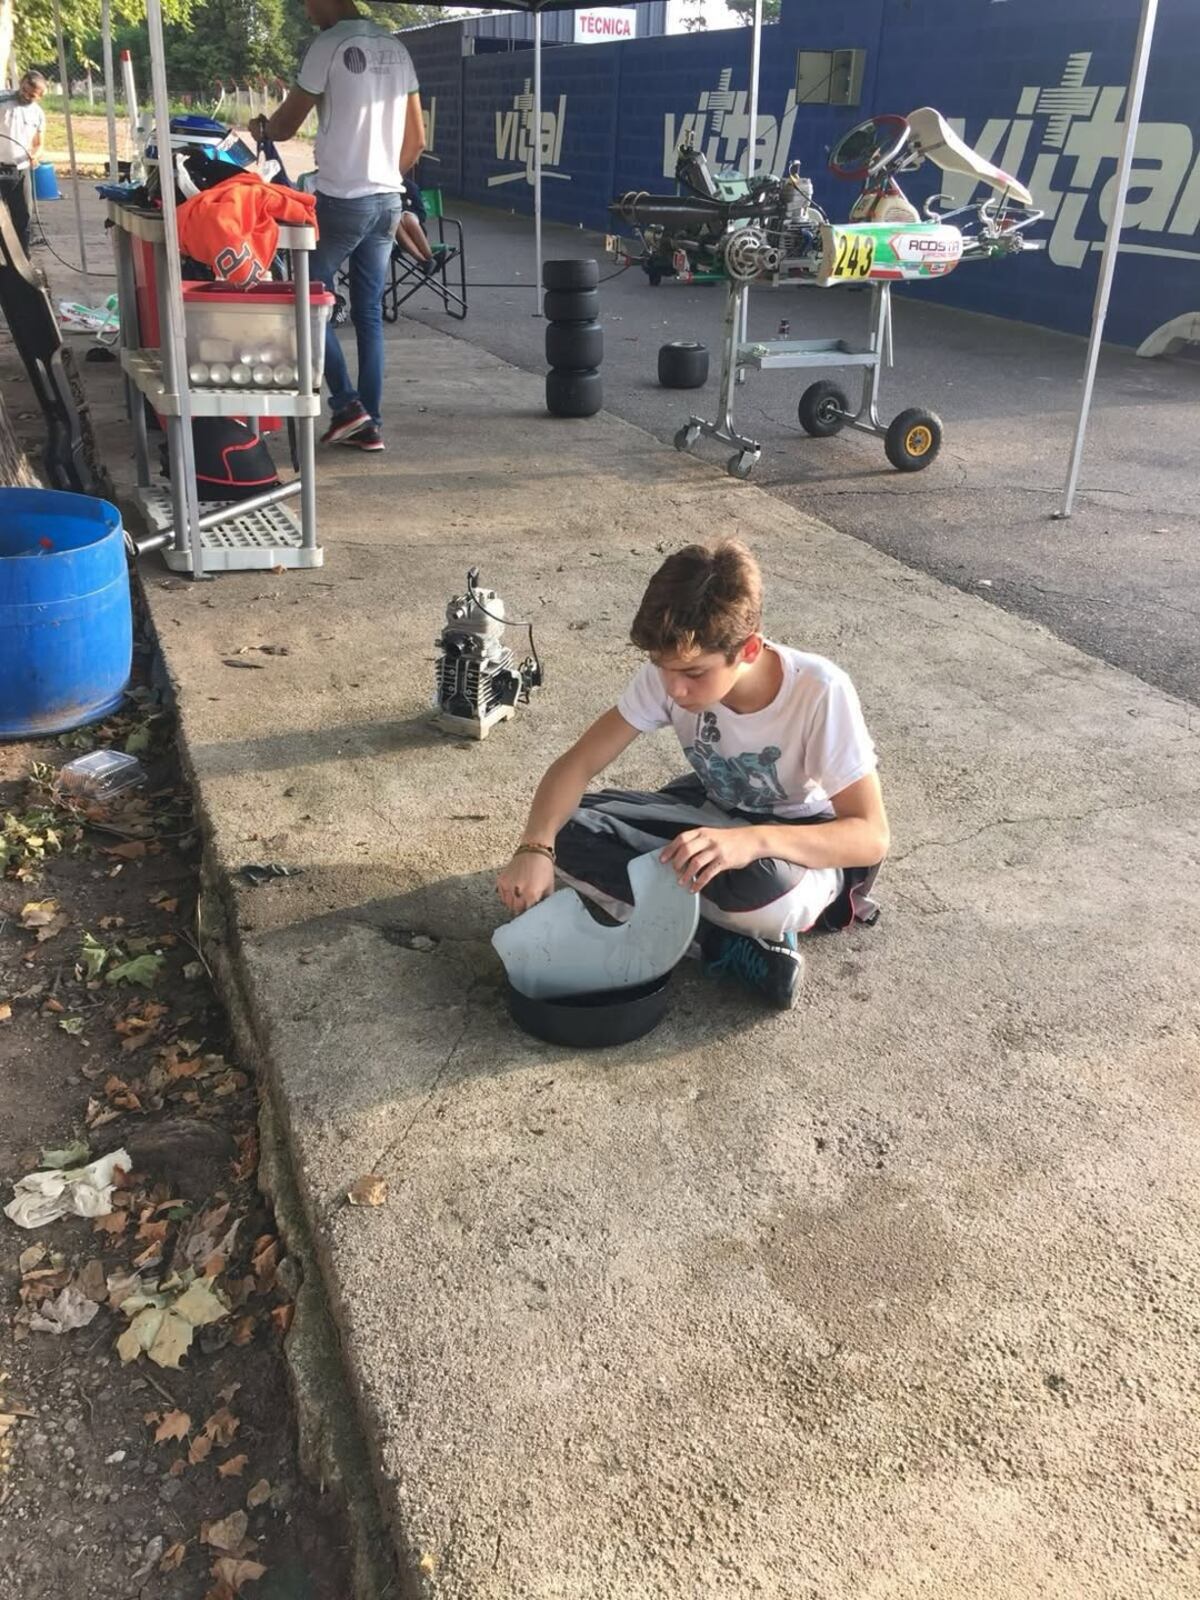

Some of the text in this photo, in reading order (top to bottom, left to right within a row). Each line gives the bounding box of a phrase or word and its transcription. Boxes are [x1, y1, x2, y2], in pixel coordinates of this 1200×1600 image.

[579, 13, 631, 36] TÉCNICA
[495, 78, 567, 185] vital
[663, 68, 799, 180] vital
[834, 235, 874, 276] 243
